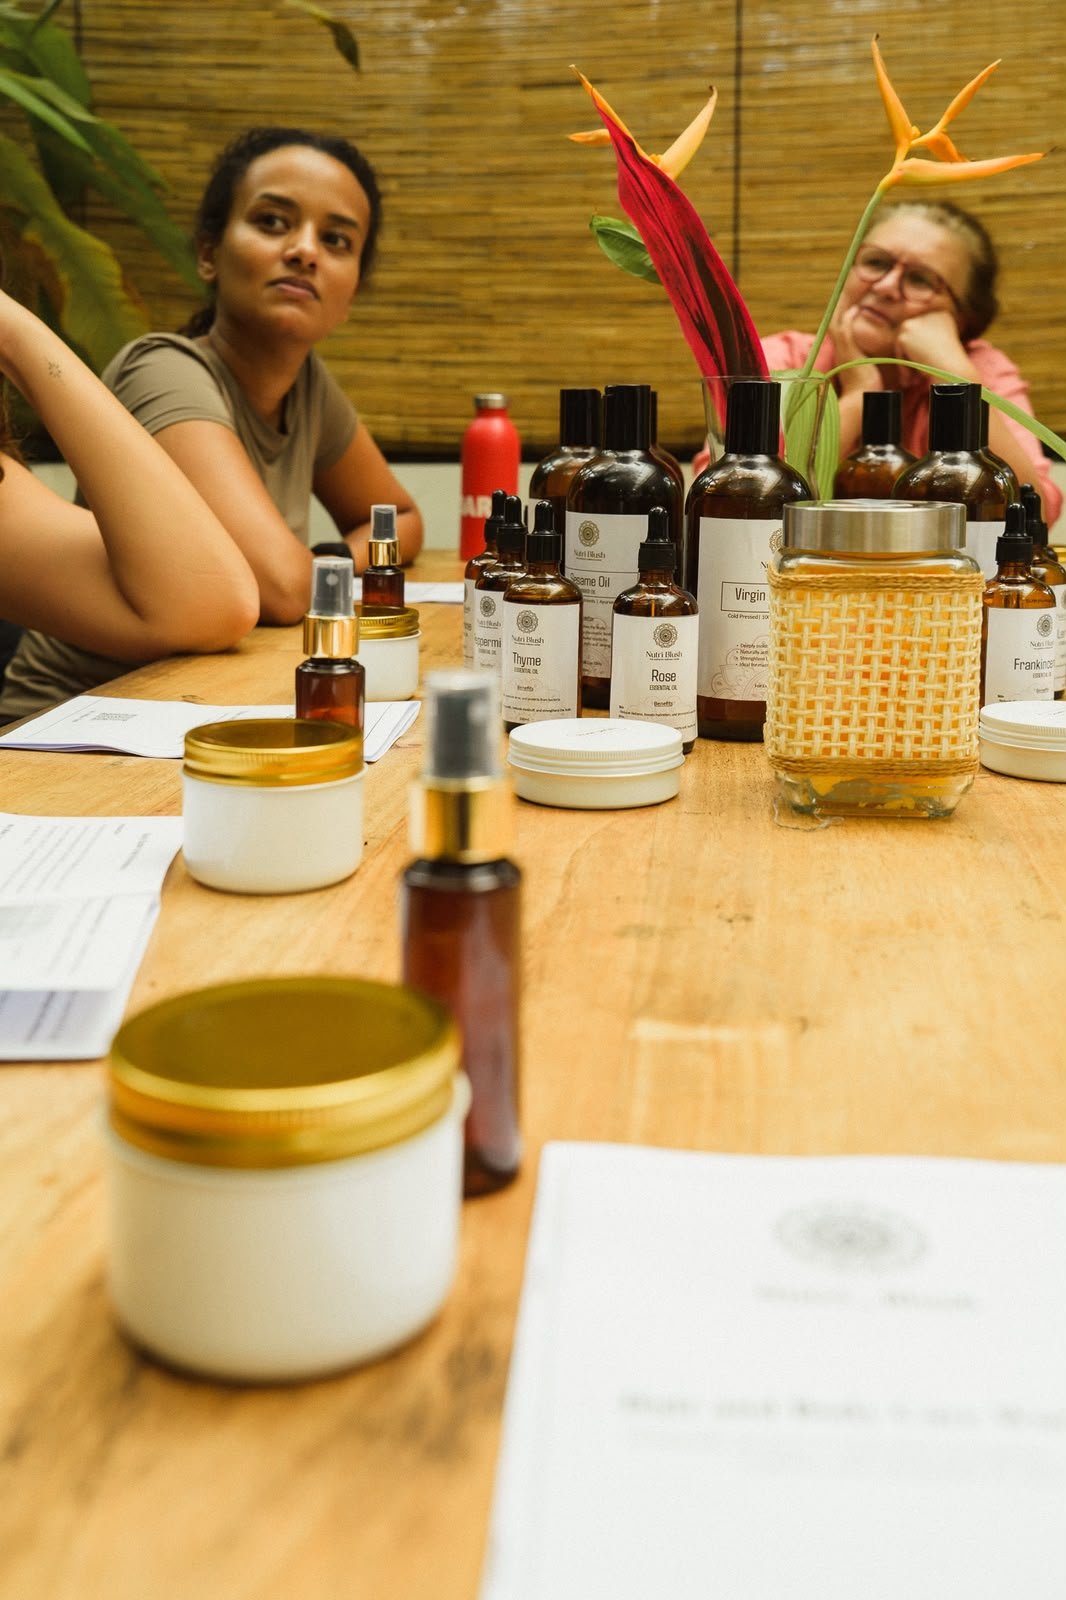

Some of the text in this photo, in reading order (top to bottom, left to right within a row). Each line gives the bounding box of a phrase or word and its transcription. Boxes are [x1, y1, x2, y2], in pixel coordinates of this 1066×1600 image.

[588, 551, 606, 559] Blush
[598, 576, 610, 588] Oil
[736, 587, 766, 603] Virgin
[513, 652, 542, 668] Thyme
[652, 669, 676, 682] Rose
